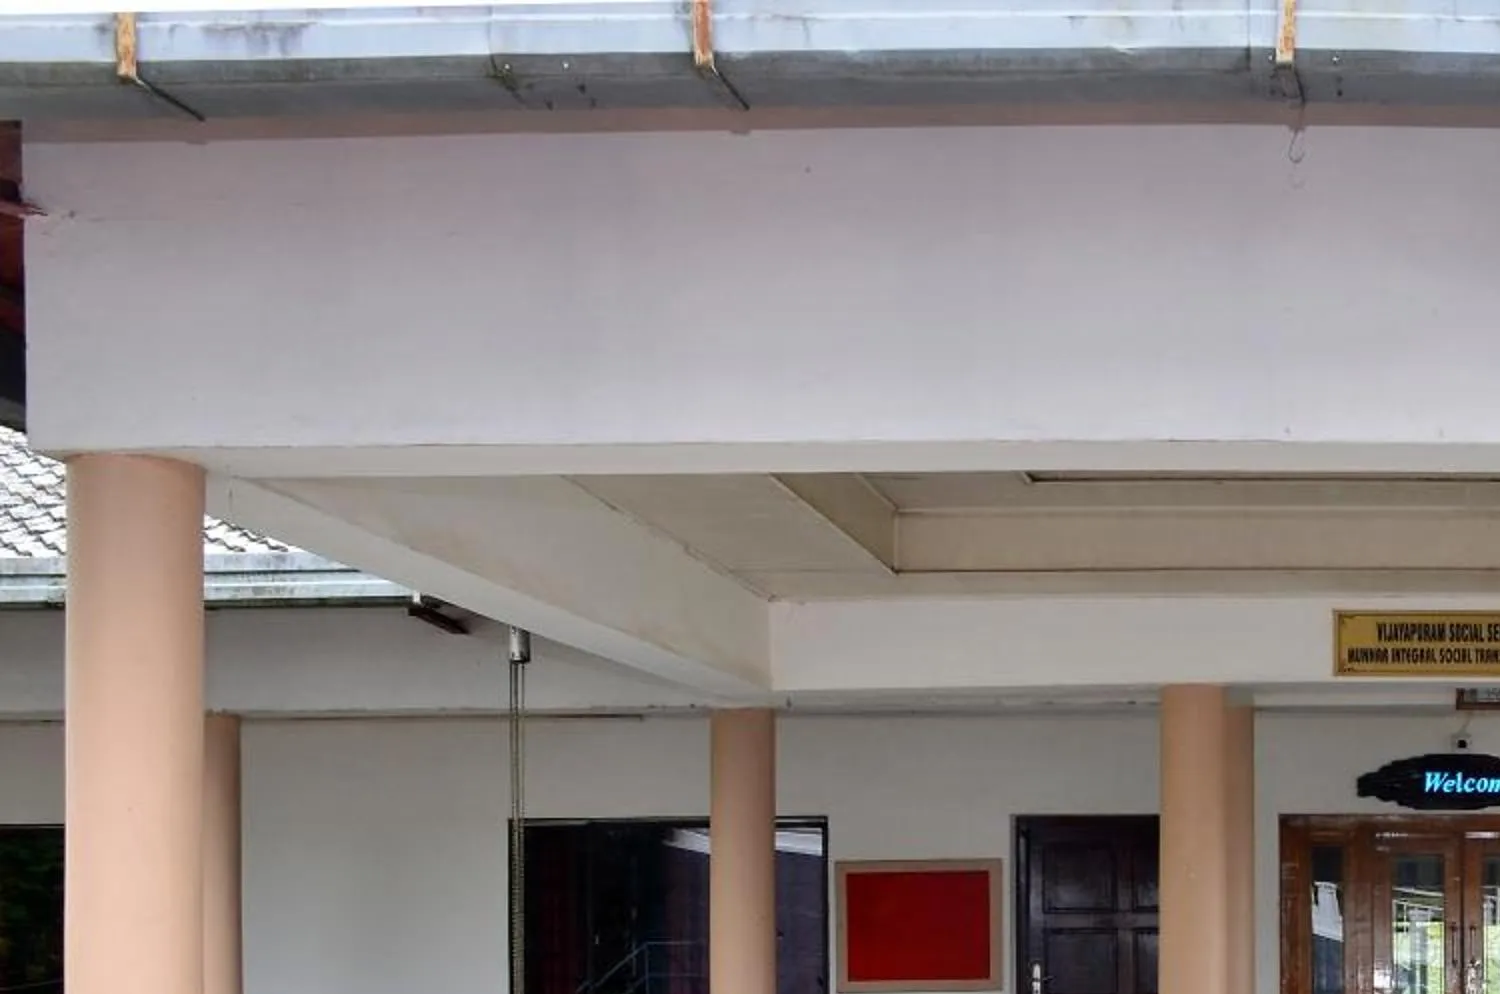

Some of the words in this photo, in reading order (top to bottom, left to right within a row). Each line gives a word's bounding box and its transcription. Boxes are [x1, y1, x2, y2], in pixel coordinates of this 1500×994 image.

[1376, 623, 1446, 643] VIJAYAPURAM
[1449, 623, 1485, 643] SOCIAL
[1348, 647, 1389, 664] MUNNAR
[1391, 647, 1437, 664] INTEGRAL
[1440, 647, 1473, 664] SOCIAL
